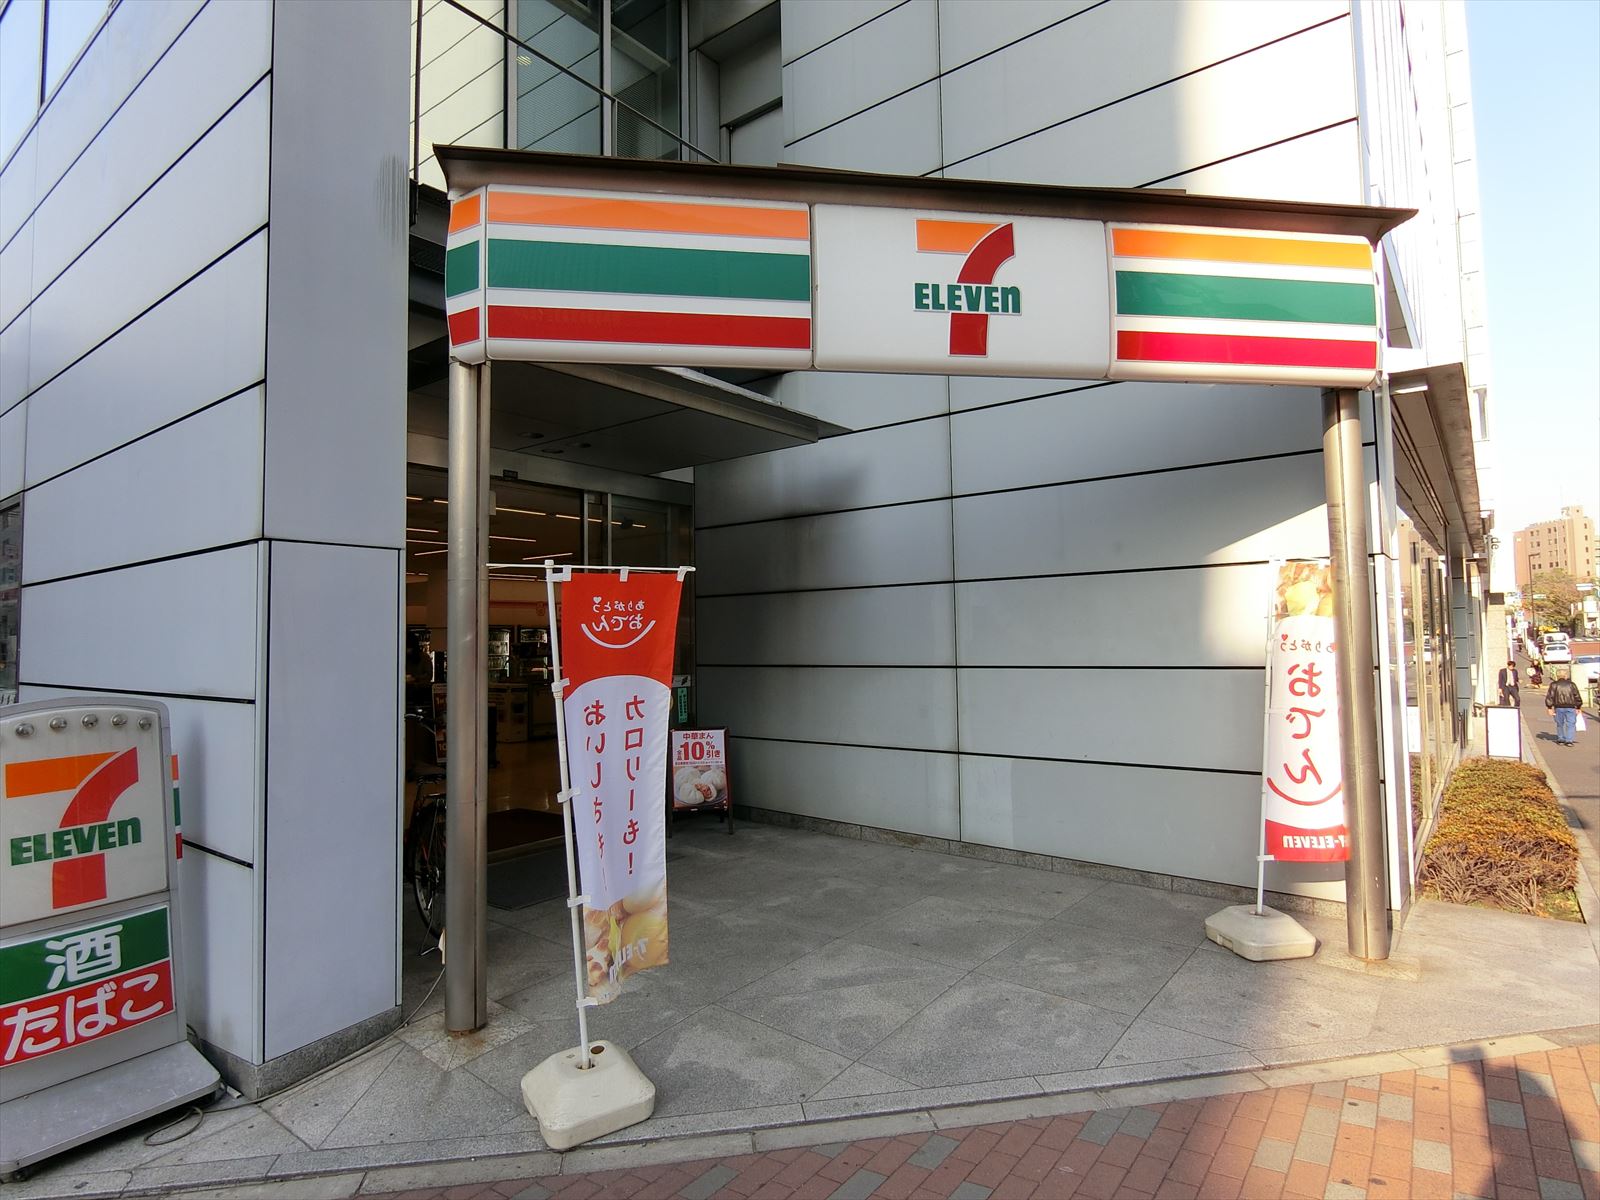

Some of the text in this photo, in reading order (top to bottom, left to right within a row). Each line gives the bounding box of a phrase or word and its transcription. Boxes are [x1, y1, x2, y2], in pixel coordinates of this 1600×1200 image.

[683, 732, 714, 740] 中華まん
[45, 924, 123, 990] 酒
[4, 972, 164, 1062] たばこ
